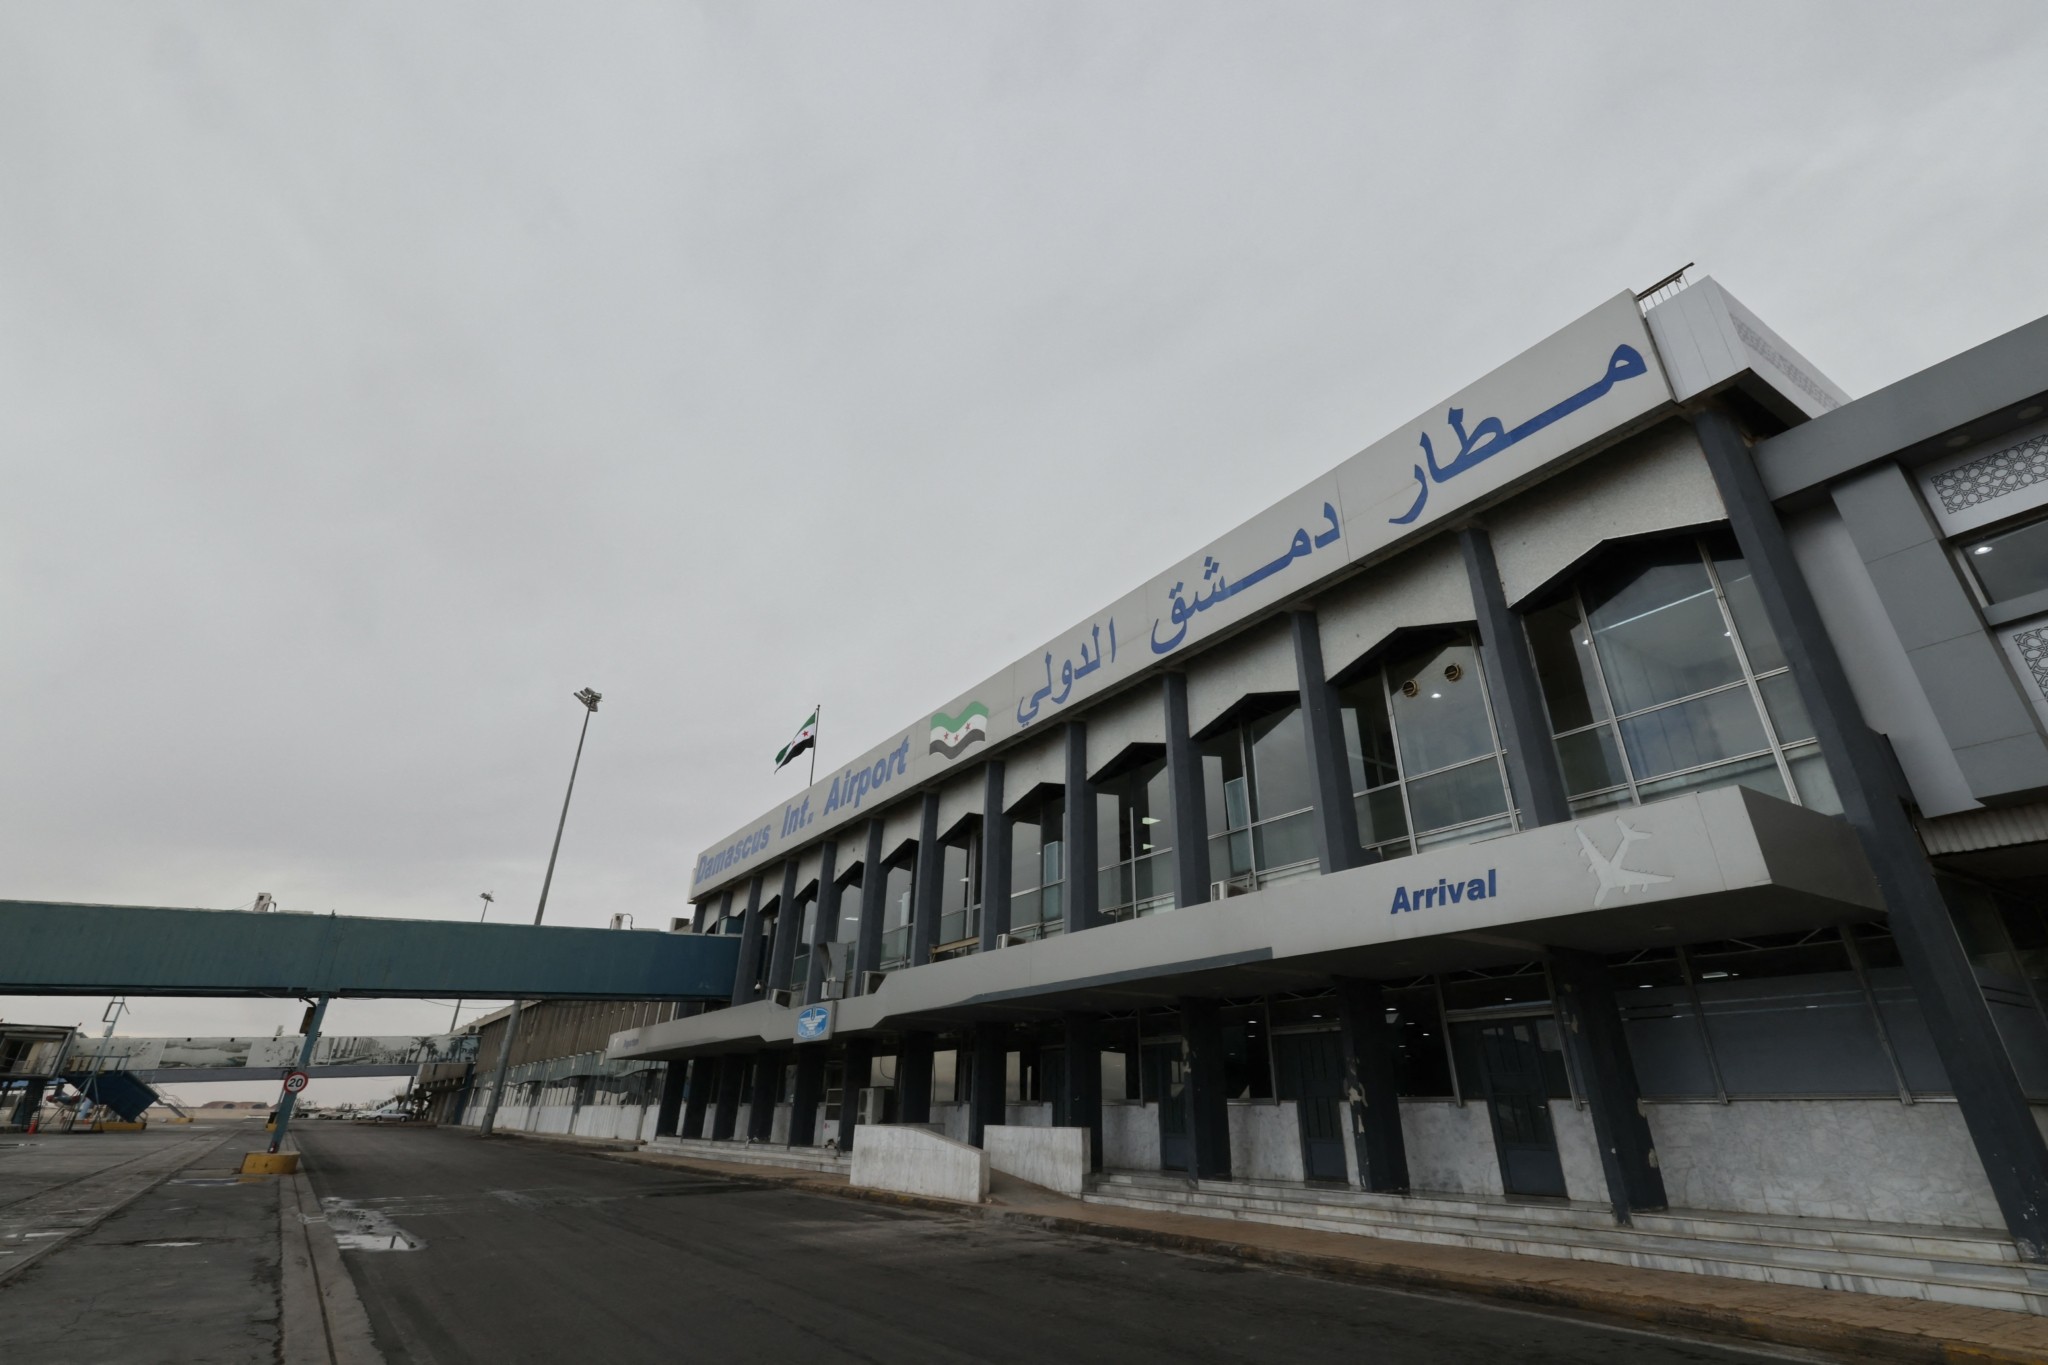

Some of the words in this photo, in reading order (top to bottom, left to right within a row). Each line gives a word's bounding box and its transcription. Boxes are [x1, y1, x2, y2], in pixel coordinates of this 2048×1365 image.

[1388, 343, 1648, 525] مطار
[1151, 502, 1341, 655] دمشق
[1016, 616, 1117, 728] الدولي
[695, 824, 772, 885] Damascus
[780, 795, 815, 839] Int.
[823, 735, 910, 817] Airport
[1390, 868, 1497, 915] Arrival
[288, 1078, 304, 1088] 20
